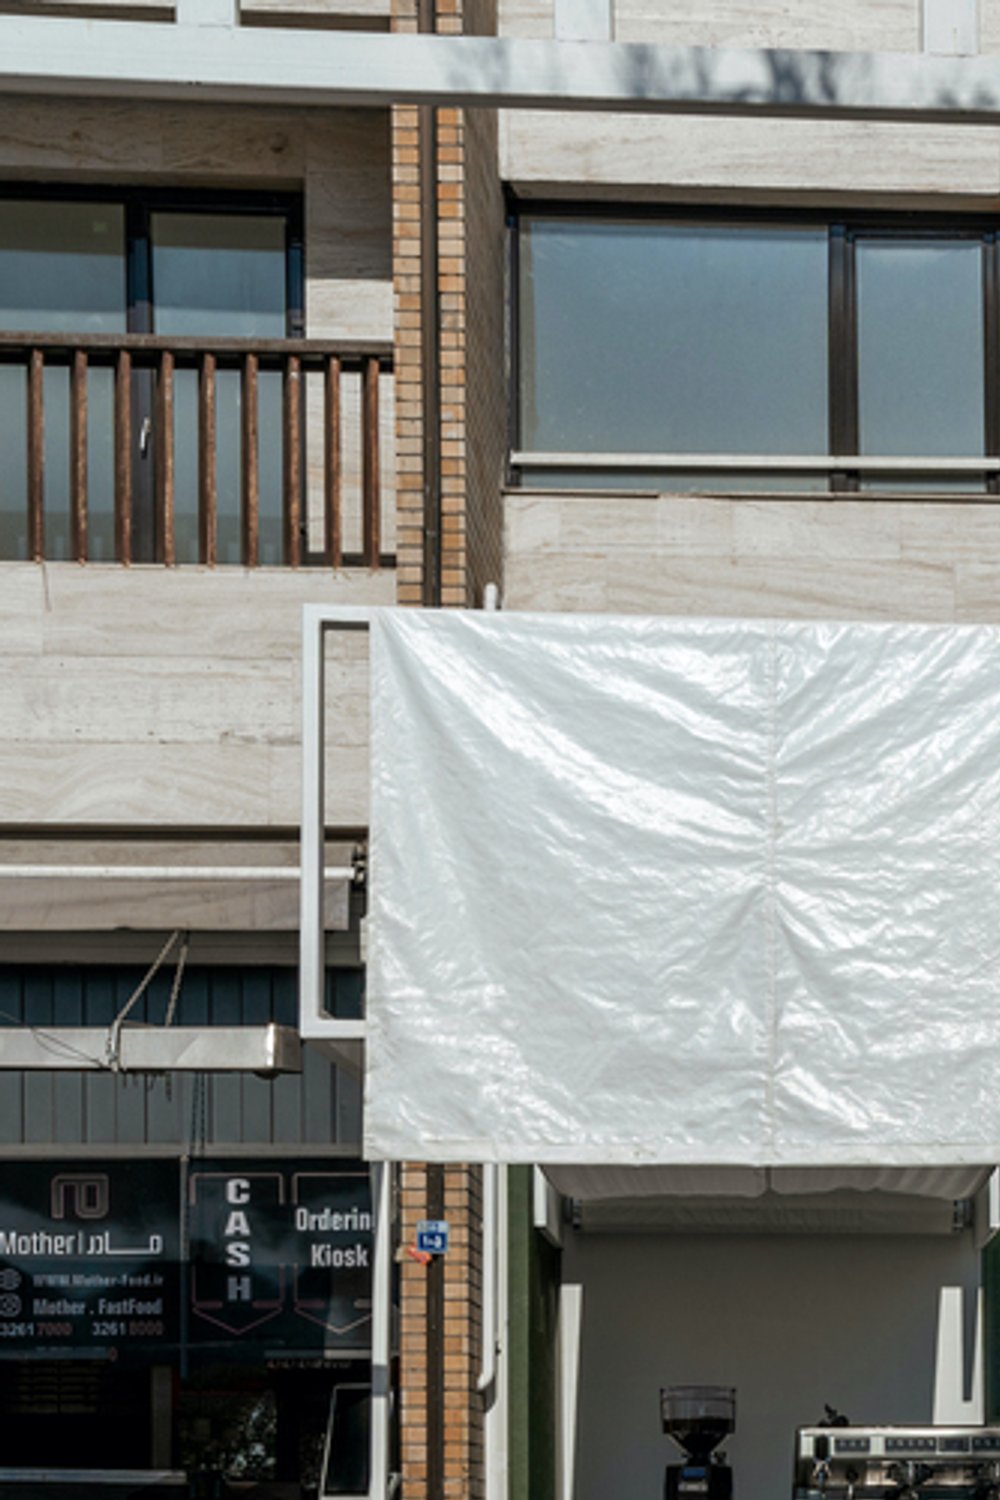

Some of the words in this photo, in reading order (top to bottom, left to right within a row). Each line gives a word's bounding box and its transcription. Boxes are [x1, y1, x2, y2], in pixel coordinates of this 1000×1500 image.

[295, 1207, 373, 1232] Orderin
[0, 1230, 76, 1255] Mother
[225, 1178, 251, 1302] CASH
[310, 1243, 369, 1268] Kiosk
